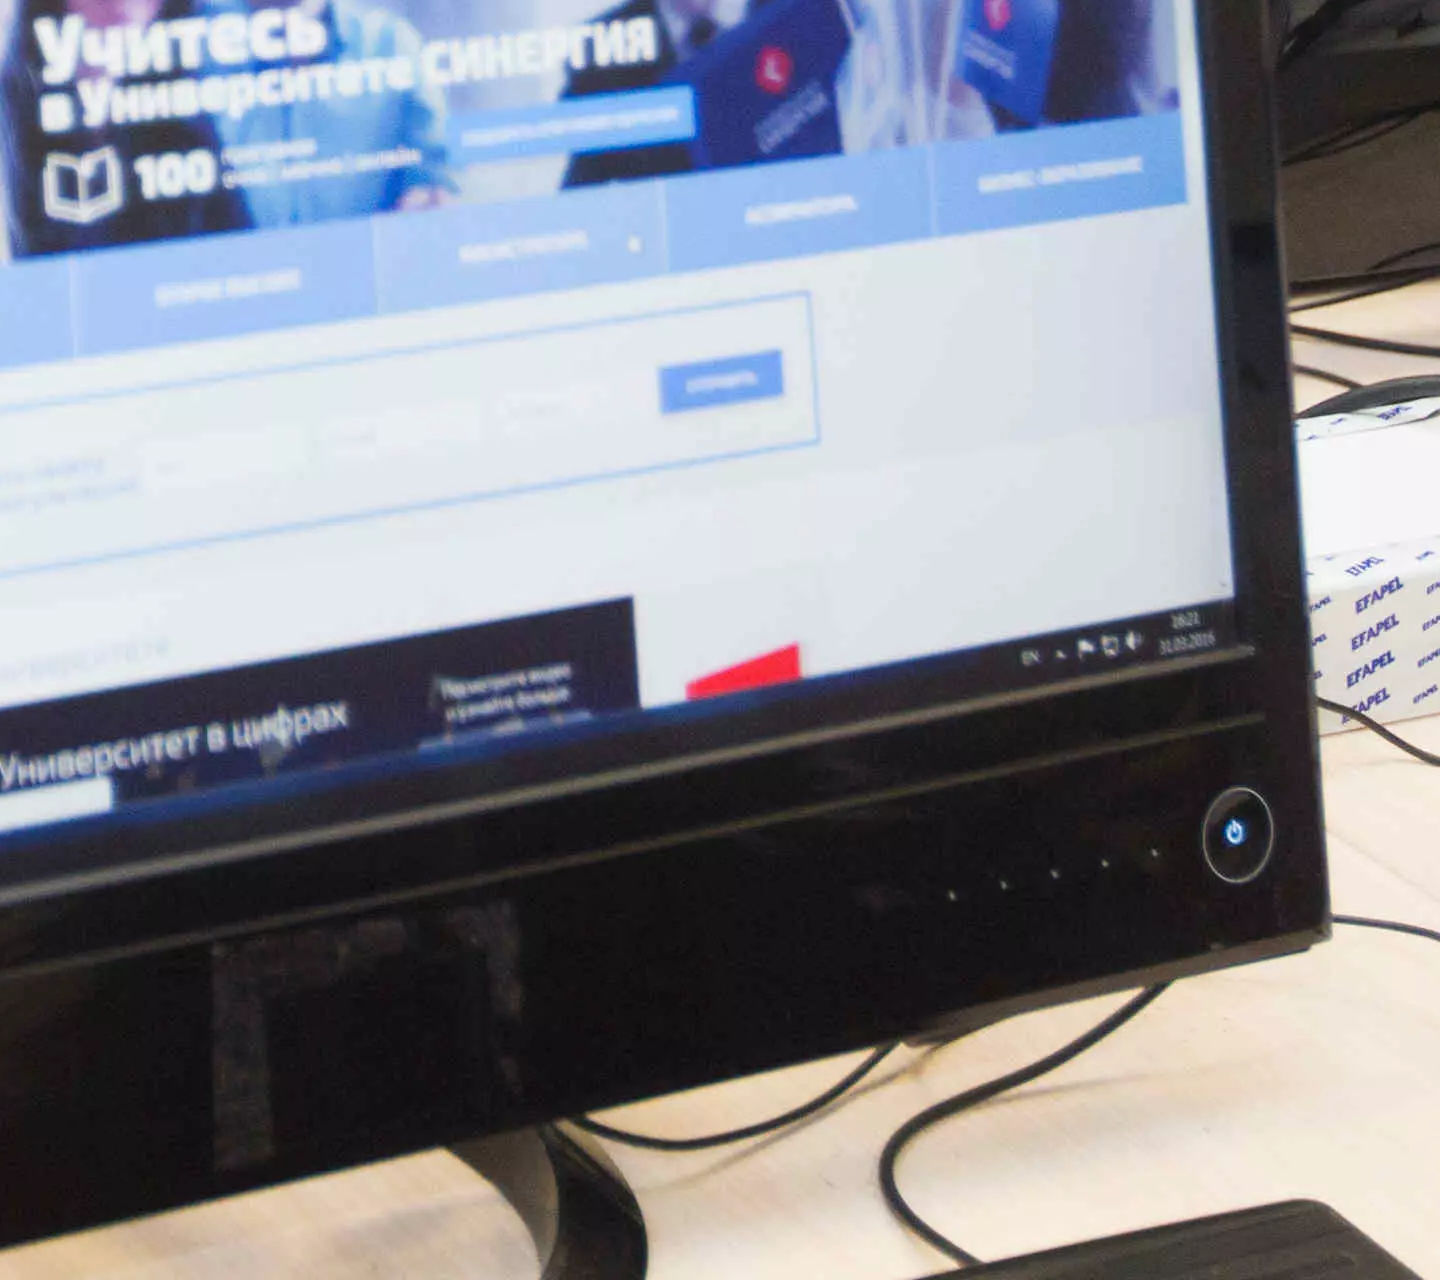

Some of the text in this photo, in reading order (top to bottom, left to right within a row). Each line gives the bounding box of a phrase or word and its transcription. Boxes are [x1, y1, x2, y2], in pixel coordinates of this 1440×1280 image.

[32, 7, 329, 84] Учитесь
[40, 93, 74, 133] в
[75, 55, 414, 127] Университете
[421, 15, 658, 85] СИНЕРГИЯ
[132, 150, 218, 200] 100
[1355, 576, 1405, 613] EFAPEL
[1351, 613, 1400, 651] EFAPEL
[1346, 650, 1396, 688] EFAPEL
[206, 722, 228, 753] в
[232, 700, 350, 748] цифрах
